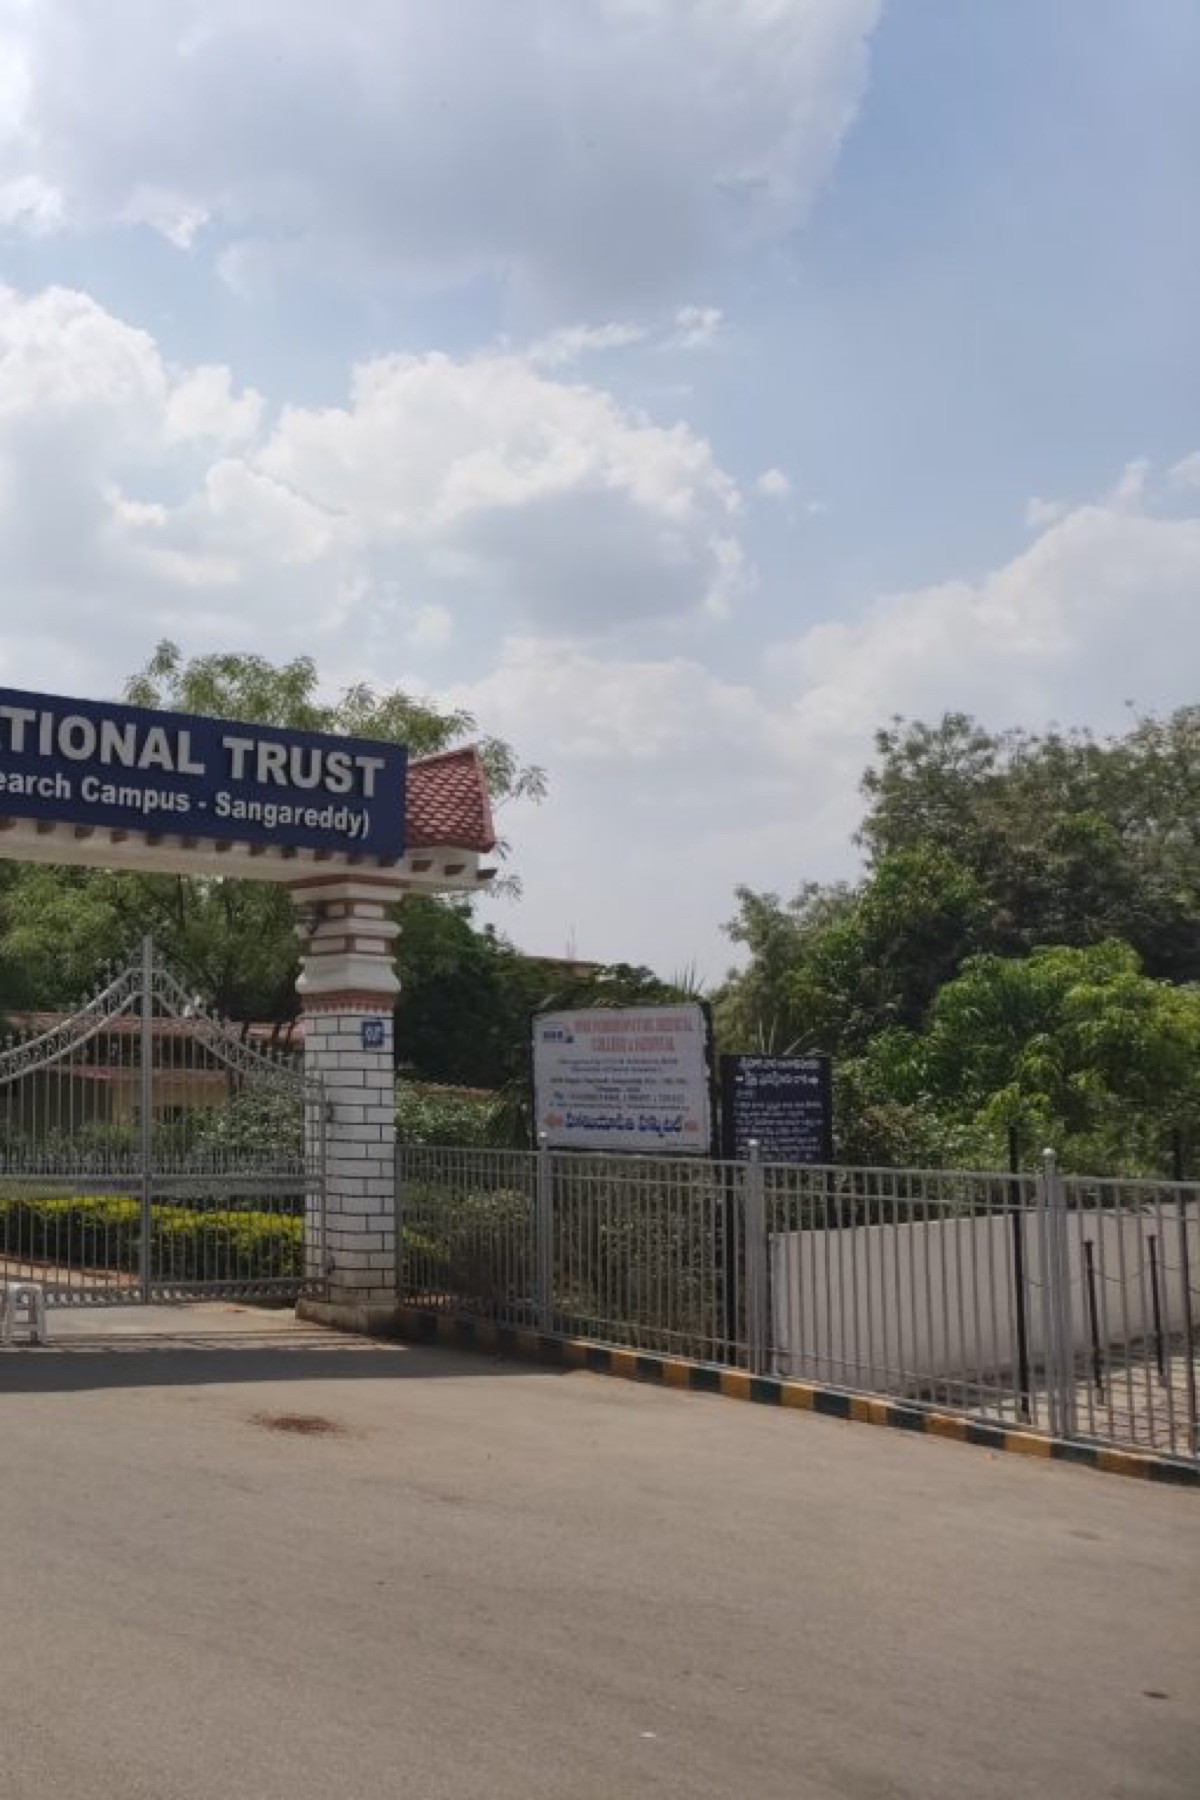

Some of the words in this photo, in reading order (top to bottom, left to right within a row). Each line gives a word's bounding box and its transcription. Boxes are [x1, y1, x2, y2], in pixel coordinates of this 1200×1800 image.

[222, 736, 385, 797] TRUST
[81, 776, 191, 817] Campus
[215, 792, 371, 839] Sangareddy)
